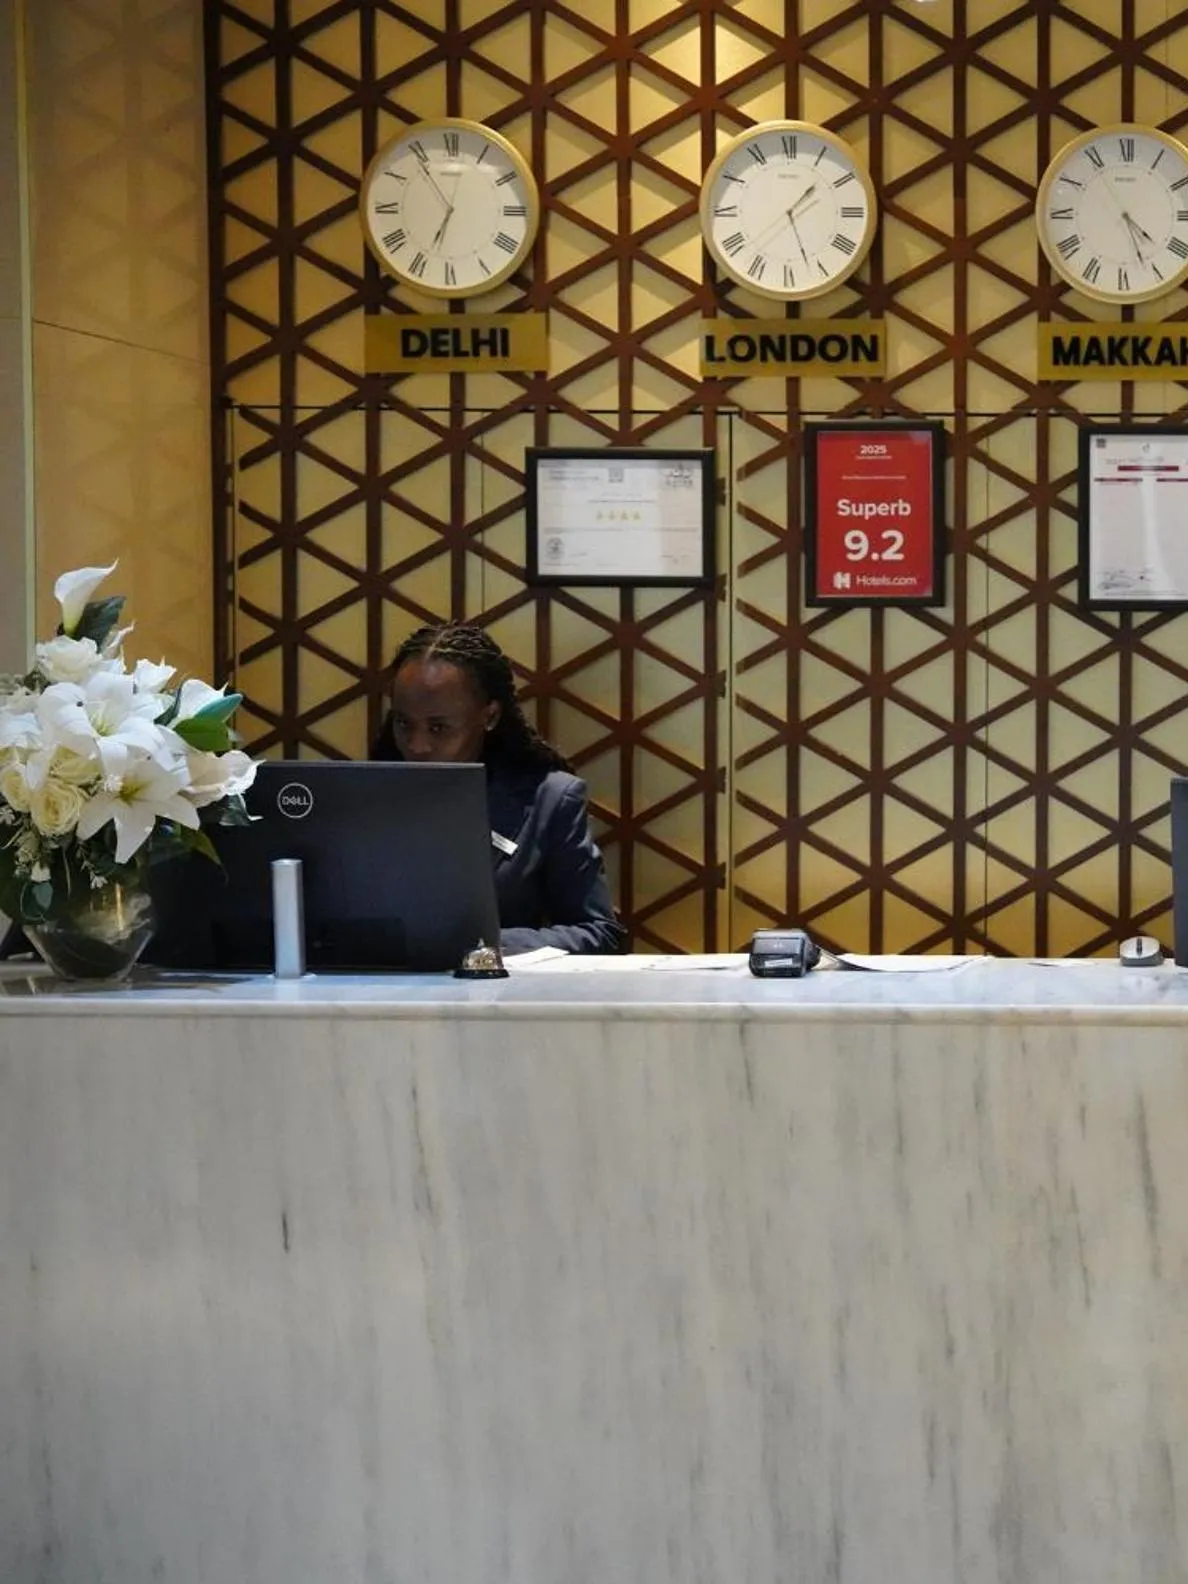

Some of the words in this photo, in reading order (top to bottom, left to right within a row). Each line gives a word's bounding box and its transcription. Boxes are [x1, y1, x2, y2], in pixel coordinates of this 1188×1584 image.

[504, 205, 526, 216] III
[841, 207, 864, 217] III
[400, 327, 510, 360] DELHI
[706, 333, 879, 364] LONDON
[860, 444, 887, 455] 2025
[837, 499, 911, 520] Superb
[844, 529, 905, 561] 9.2
[856, 574, 917, 586] Hotels.com
[282, 796, 309, 805] DELL
